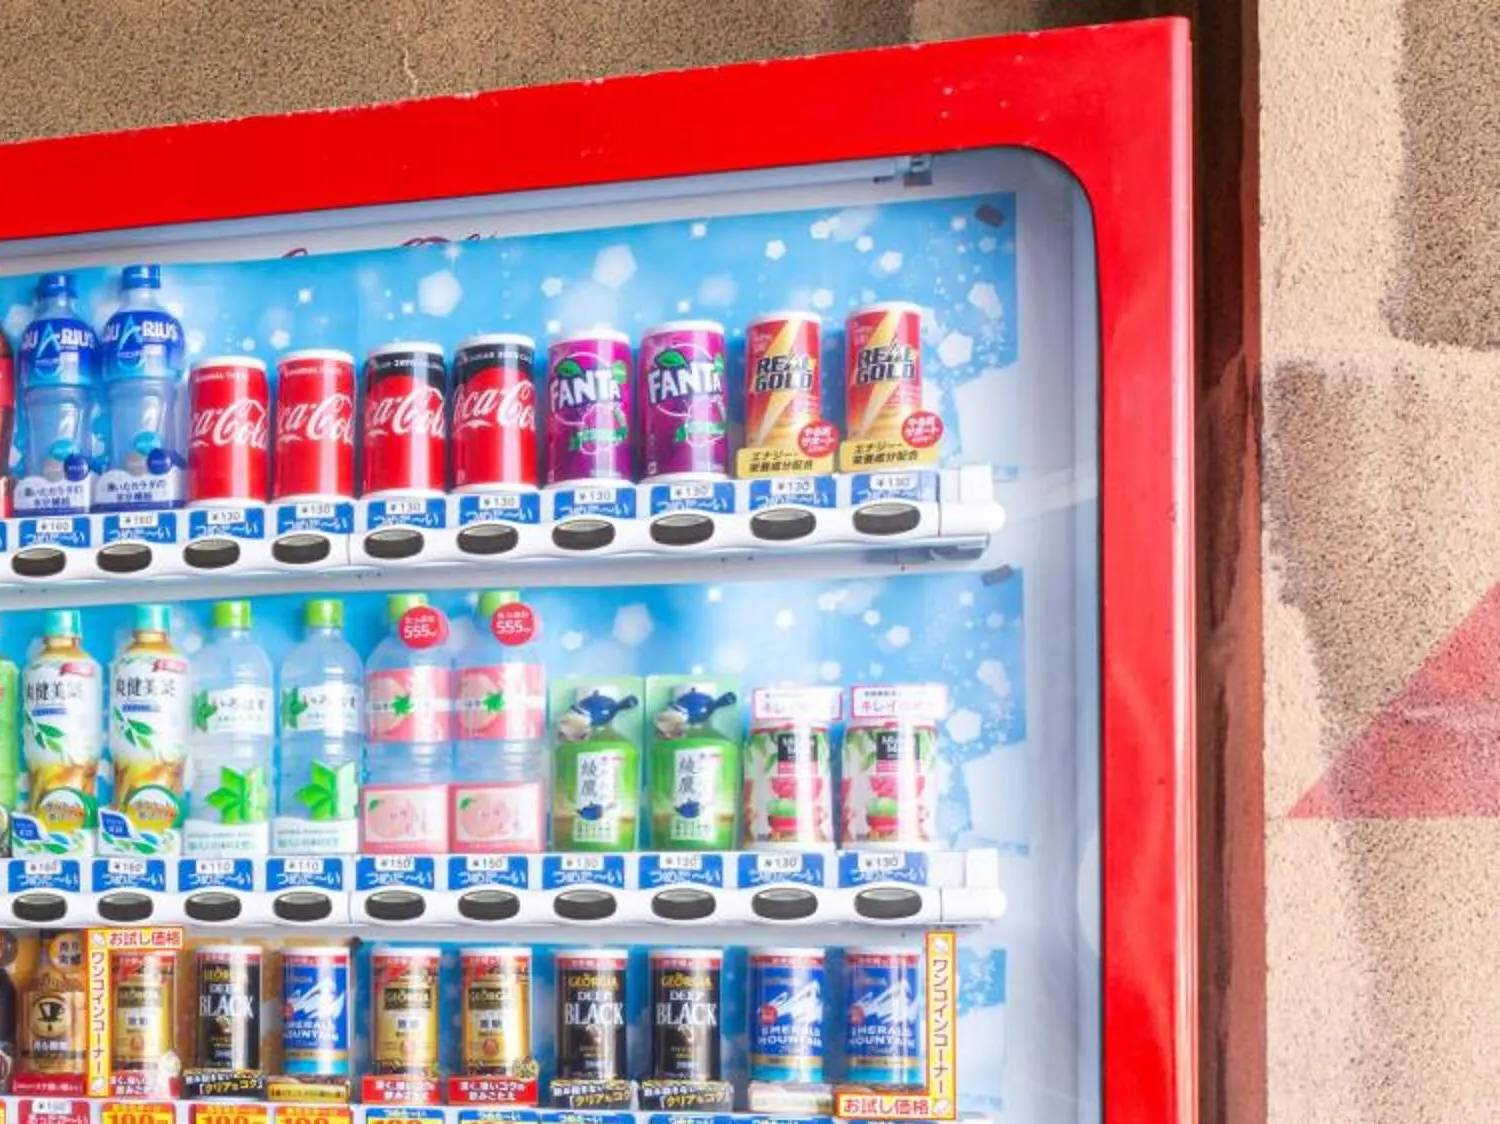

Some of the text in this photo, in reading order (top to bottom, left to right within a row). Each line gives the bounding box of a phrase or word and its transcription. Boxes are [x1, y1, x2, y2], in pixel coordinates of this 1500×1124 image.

[757, 353, 813, 373] REAL
[858, 346, 914, 369] REAL
[648, 362, 722, 404] FANTA
[755, 371, 813, 393] GOLD
[856, 363, 915, 384] GOLD
[550, 370, 621, 411] FANTA
[109, 931, 182, 946] お試し価格
[91, 951, 106, 1075] ワンコインコーナー
[199, 995, 254, 1019] BLACK
[564, 1002, 624, 1025] BLACK
[656, 1002, 717, 1025] BLACK
[932, 958, 949, 1094] ワンコインコーナー
[843, 1098, 930, 1115] お試し価格
